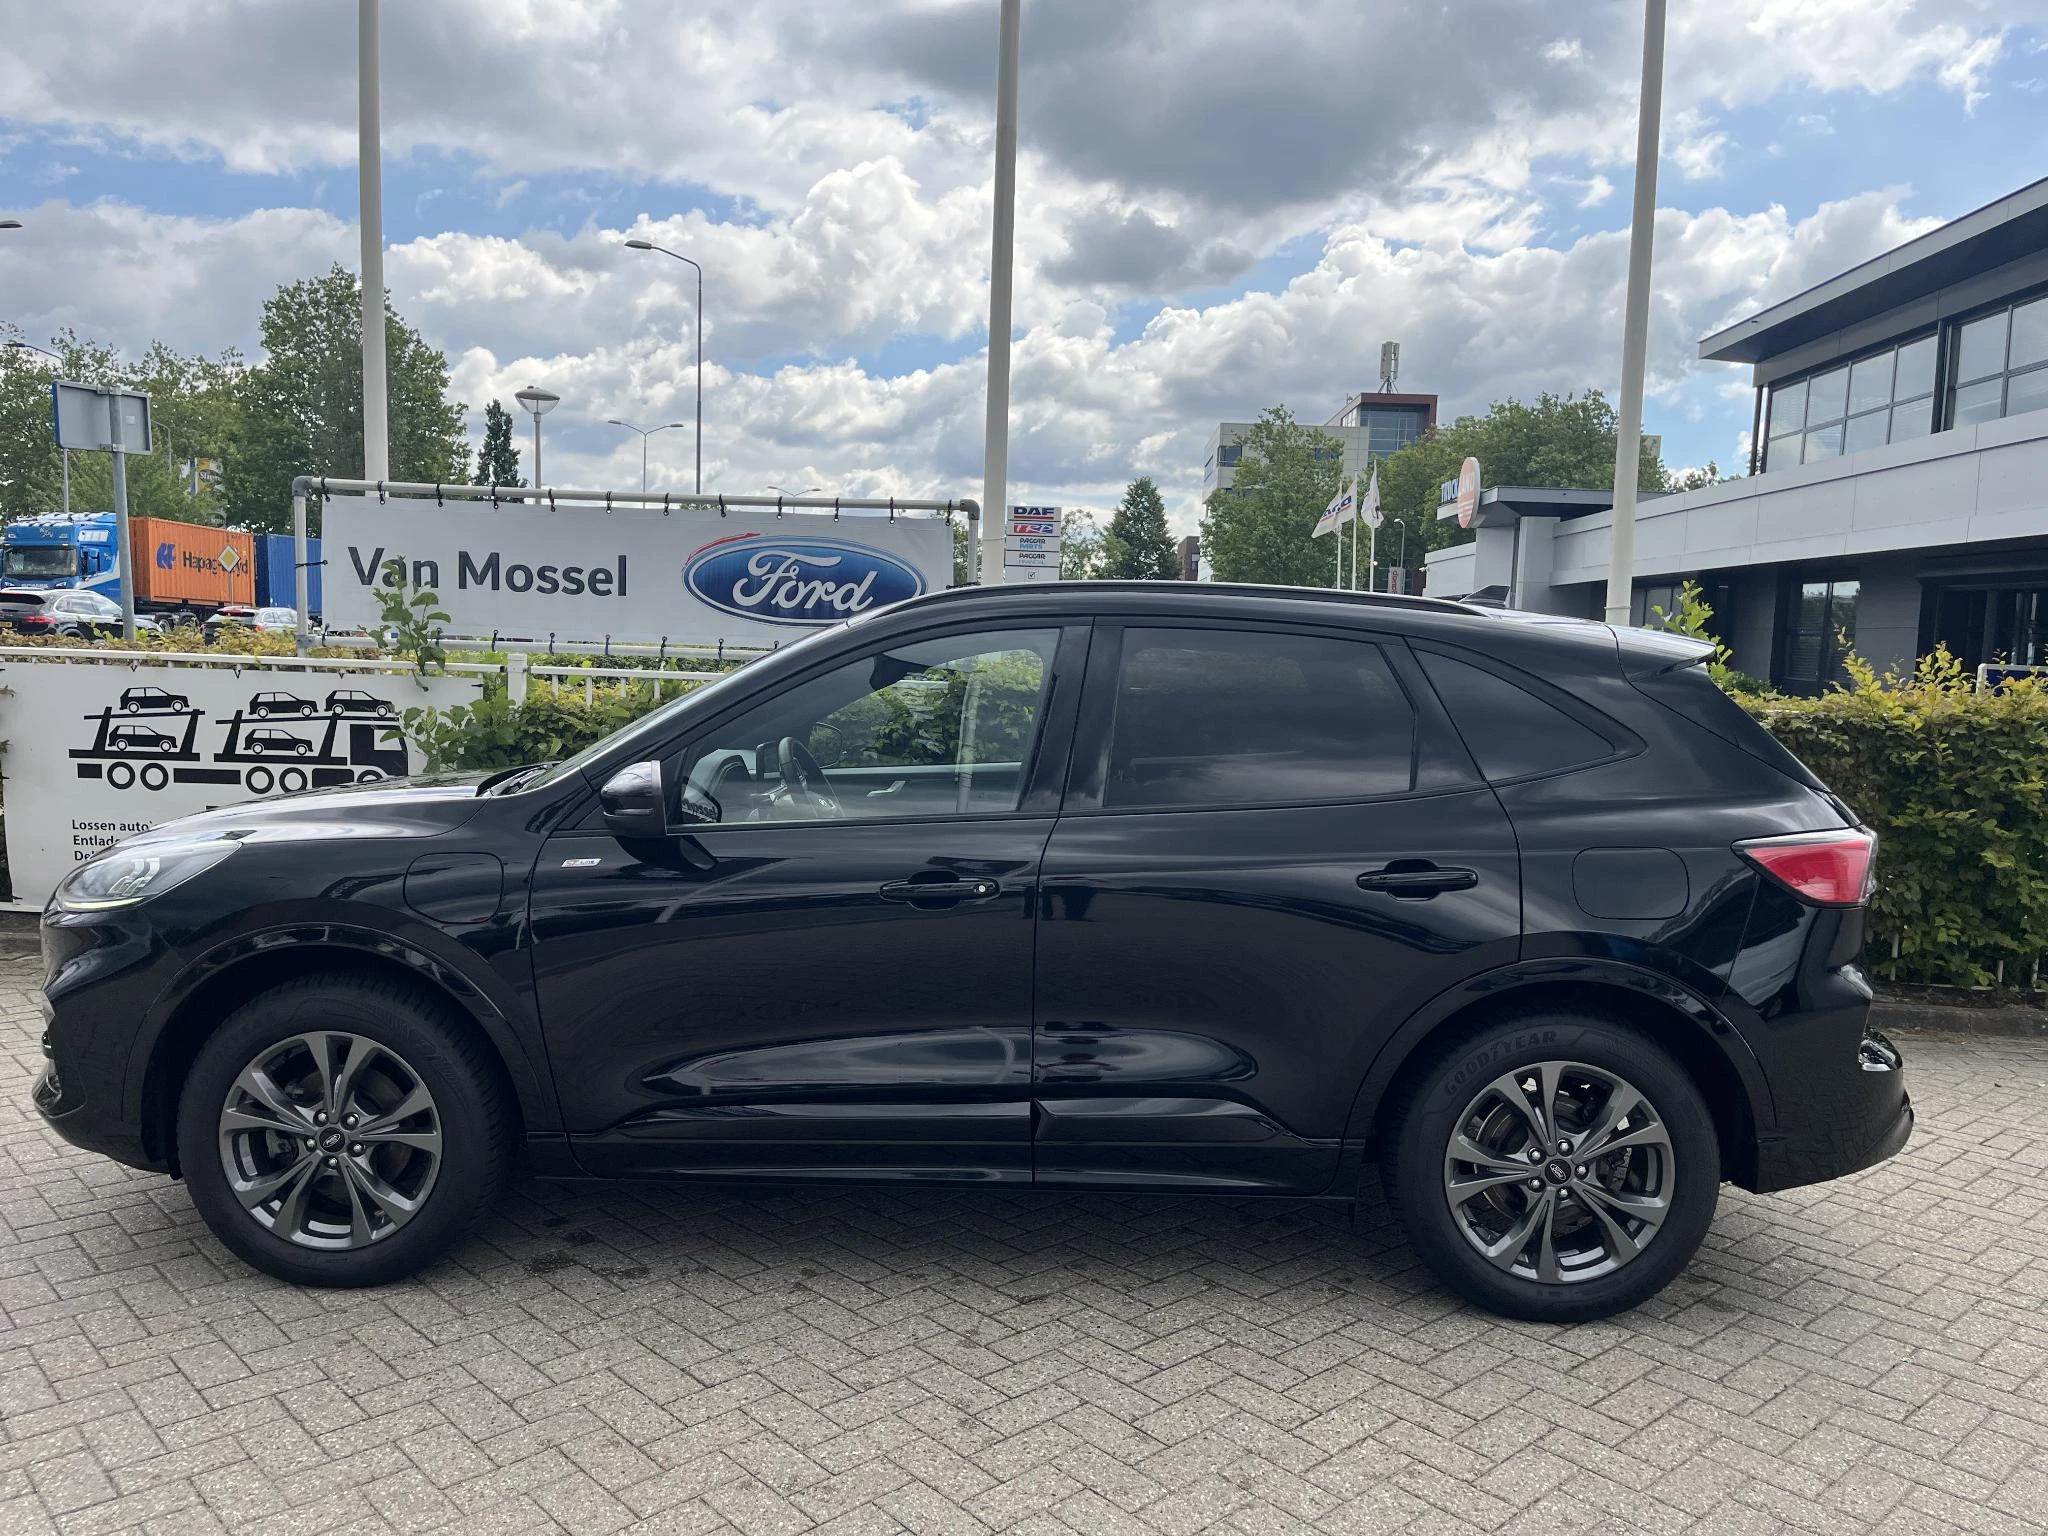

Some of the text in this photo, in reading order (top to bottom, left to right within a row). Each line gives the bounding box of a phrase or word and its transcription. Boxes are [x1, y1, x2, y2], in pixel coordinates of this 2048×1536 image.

[1013, 507, 1055, 516] DAF
[1014, 523, 1053, 534] TRP
[1019, 552, 1046, 560] PACCAR
[182, 550, 249, 577] Hapag-yd
[347, 546, 627, 597] Van Mossel
[732, 549, 878, 612] Ford
[71, 819, 153, 832] Lossen auto'
